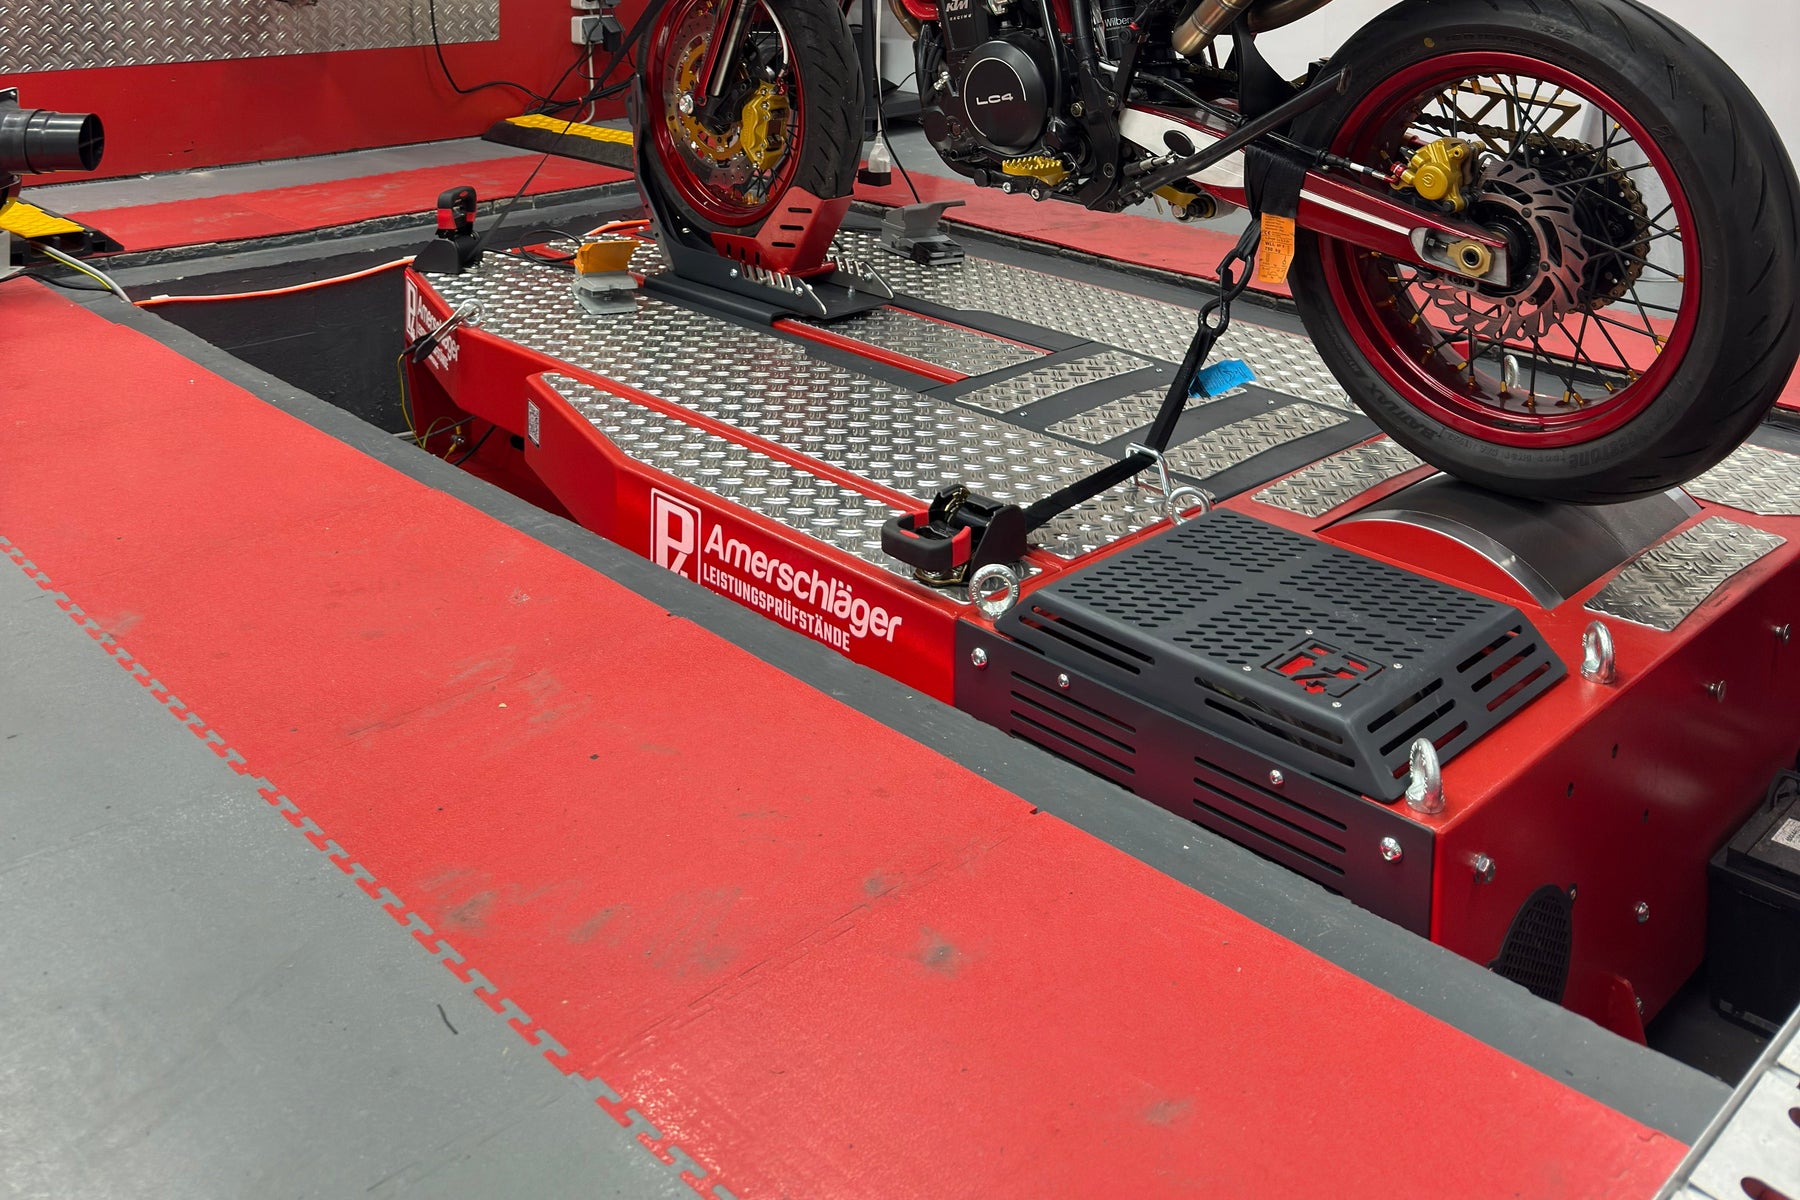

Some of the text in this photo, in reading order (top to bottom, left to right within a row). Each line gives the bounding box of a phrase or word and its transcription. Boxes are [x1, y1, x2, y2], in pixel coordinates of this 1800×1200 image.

[976, 92, 1014, 107] LC4
[703, 562, 851, 653] LEISTUNGSPRÜFSTÄNDE
[704, 523, 903, 643] Amerschläger
